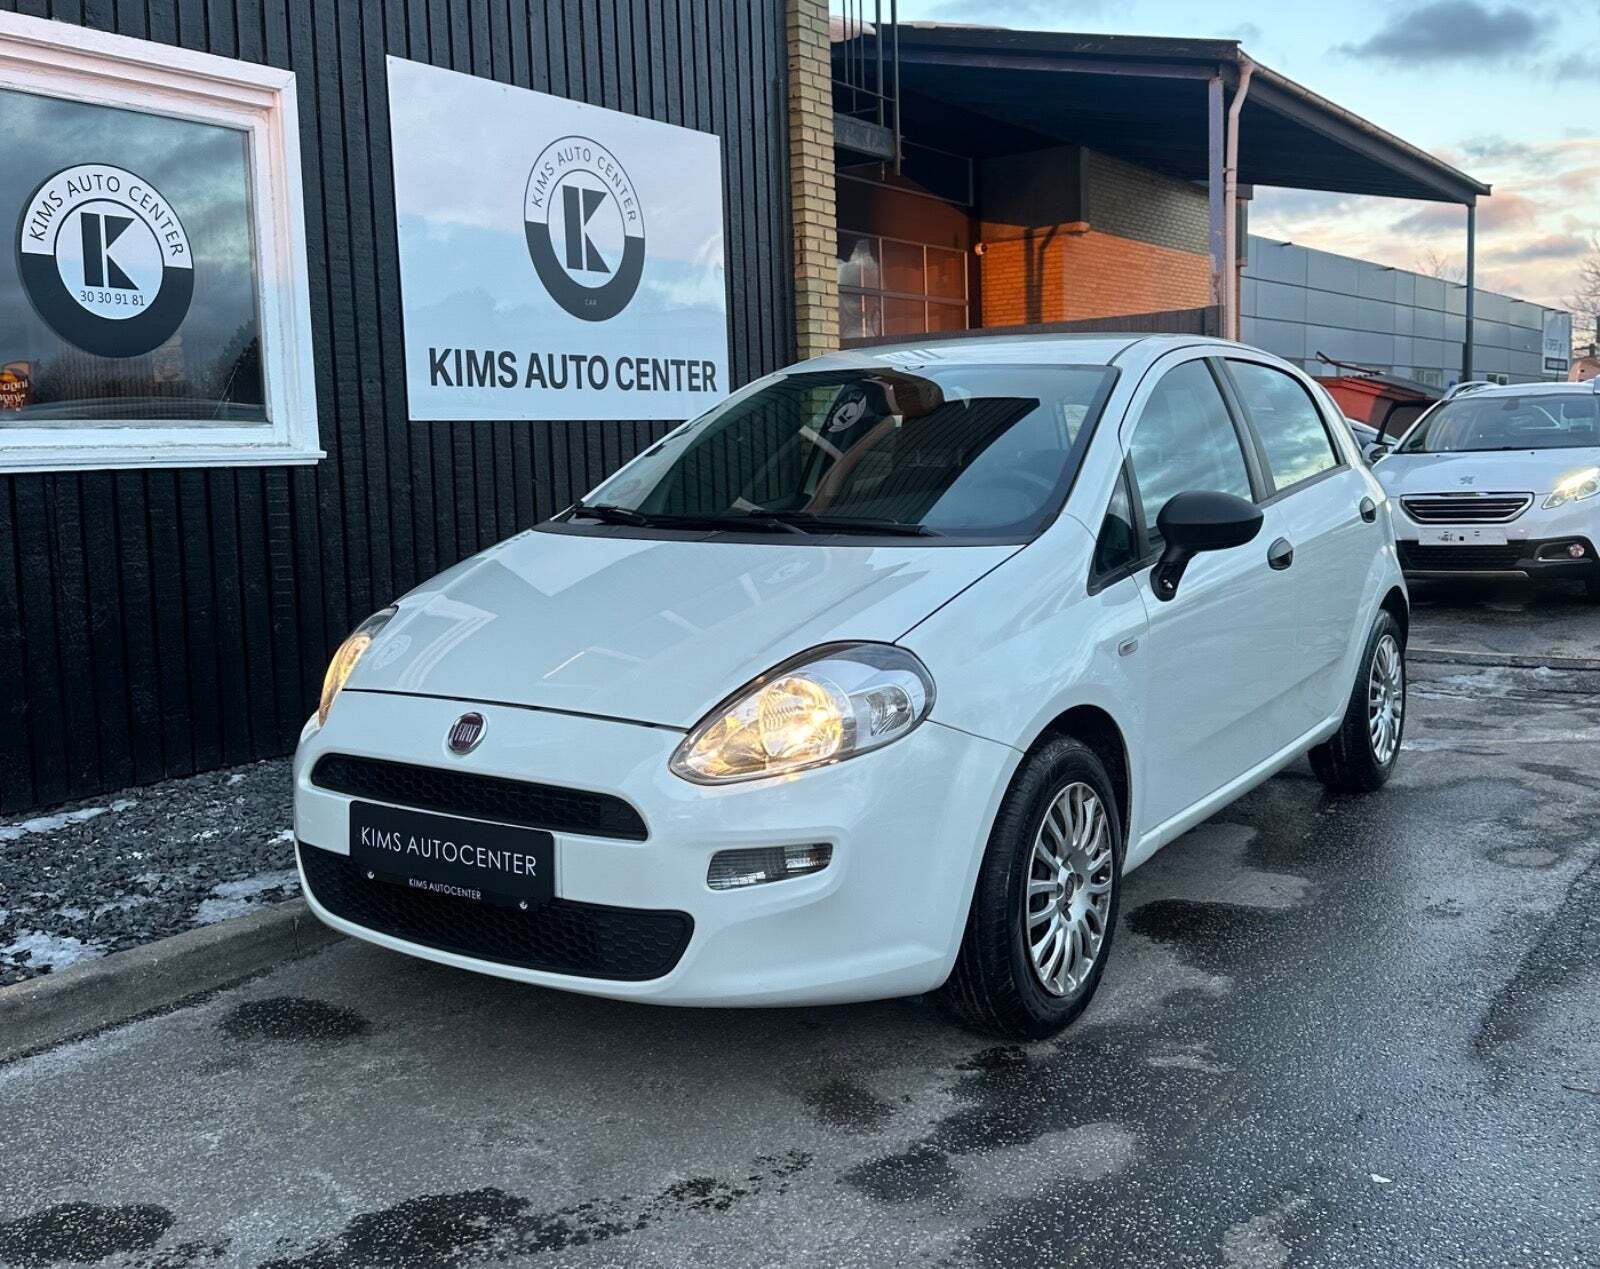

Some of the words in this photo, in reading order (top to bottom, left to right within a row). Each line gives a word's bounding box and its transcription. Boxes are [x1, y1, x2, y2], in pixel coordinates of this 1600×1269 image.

[531, 161, 555, 208] KIMS
[557, 146, 591, 166] AUTO
[597, 156, 637, 222] CENTER
[29, 190, 64, 241] KIMS
[67, 174, 120, 197] AUTO
[128, 186, 184, 256] CENTER
[80, 290, 95, 303] 30
[97, 292, 112, 304] 30
[114, 293, 128, 306] 91
[132, 295, 145, 307] 81
[429, 347, 518, 389] KIMS
[525, 352, 609, 390] AUTO
[615, 356, 718, 392] CENTER
[454, 723, 481, 743] FIAT
[361, 826, 401, 852] KIMS
[406, 835, 537, 877] AUTOCENTER
[408, 878, 428, 891] KIMS
[429, 882, 482, 900] AUTOCENTER
